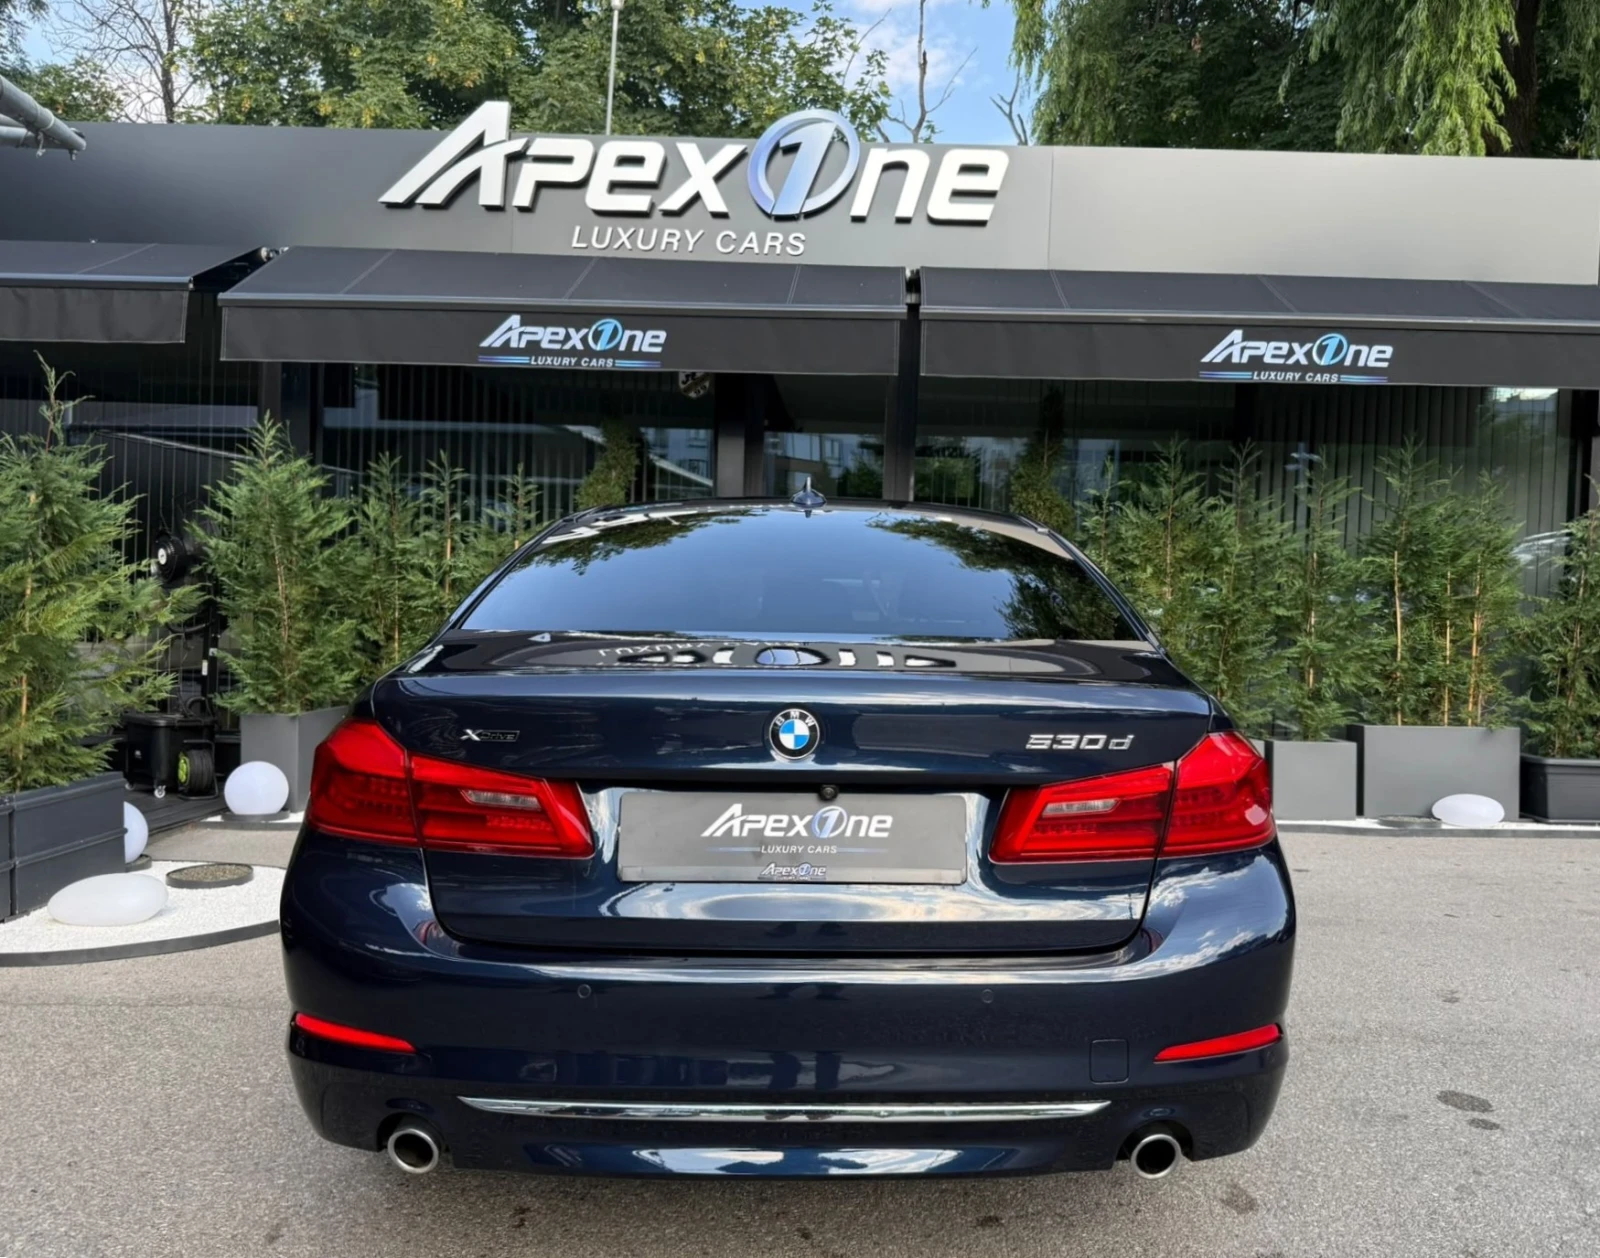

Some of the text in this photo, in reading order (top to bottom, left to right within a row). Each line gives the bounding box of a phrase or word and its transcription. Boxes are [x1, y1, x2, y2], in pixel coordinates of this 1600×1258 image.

[572, 225, 806, 256] LUXURY CARS
[531, 355, 614, 368] LUXURY CARS
[1252, 371, 1339, 383] LUXURY CARS
[1025, 734, 1135, 750] 530d
[761, 844, 837, 854] LUXURY CARS
